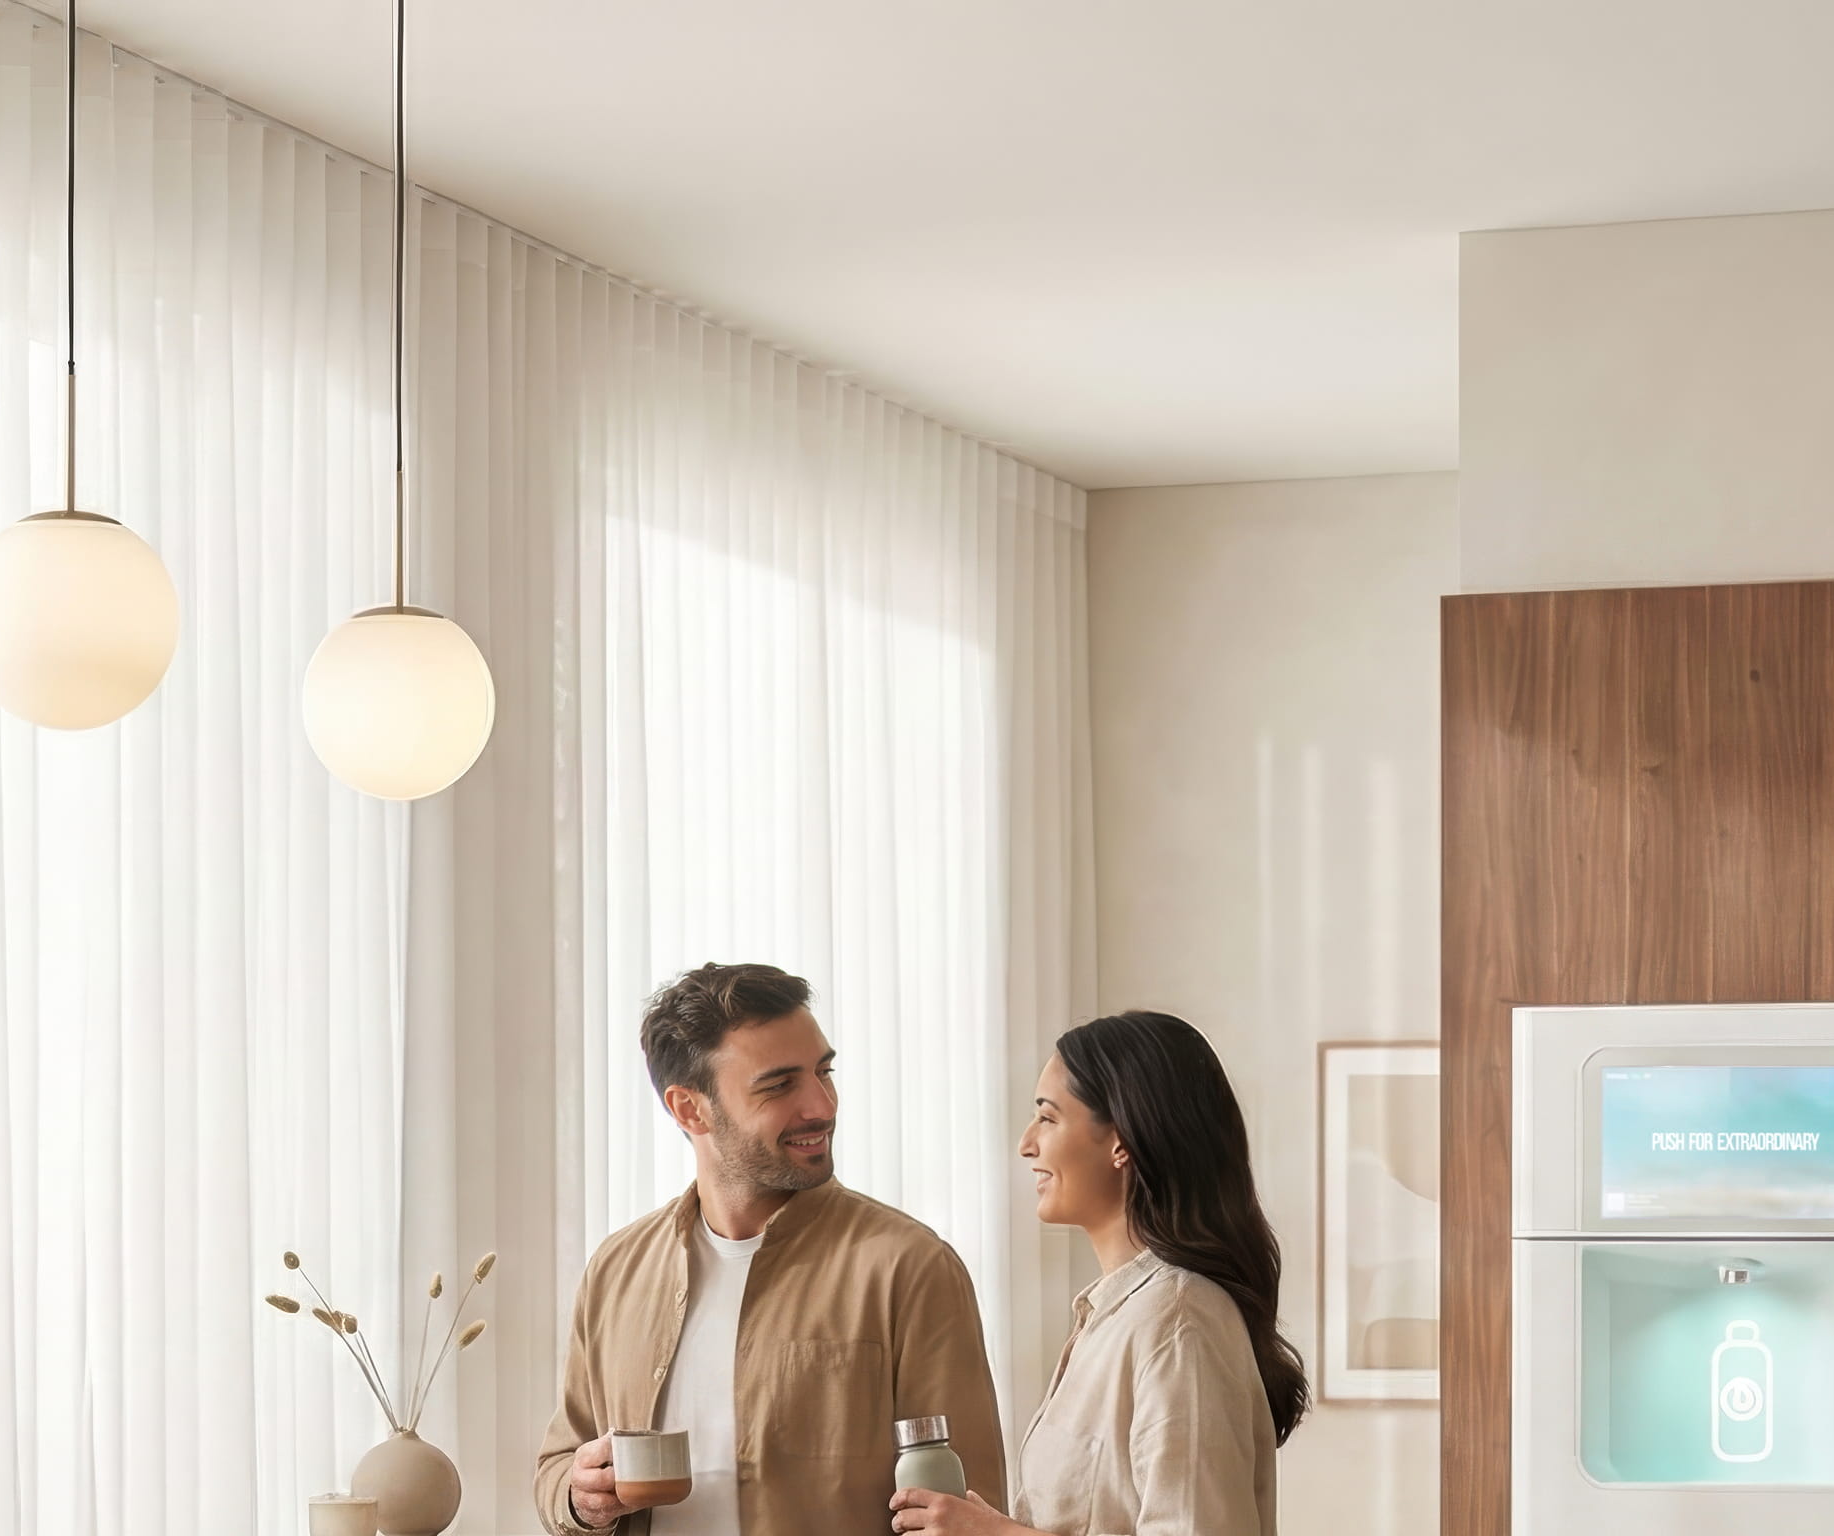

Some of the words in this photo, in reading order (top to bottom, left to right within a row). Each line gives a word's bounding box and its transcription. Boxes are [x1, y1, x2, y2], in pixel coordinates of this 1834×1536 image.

[1652, 1132, 1685, 1151] PUSH
[1688, 1132, 1713, 1151] FOR
[1717, 1132, 1820, 1151] EXTRAORDINARY
